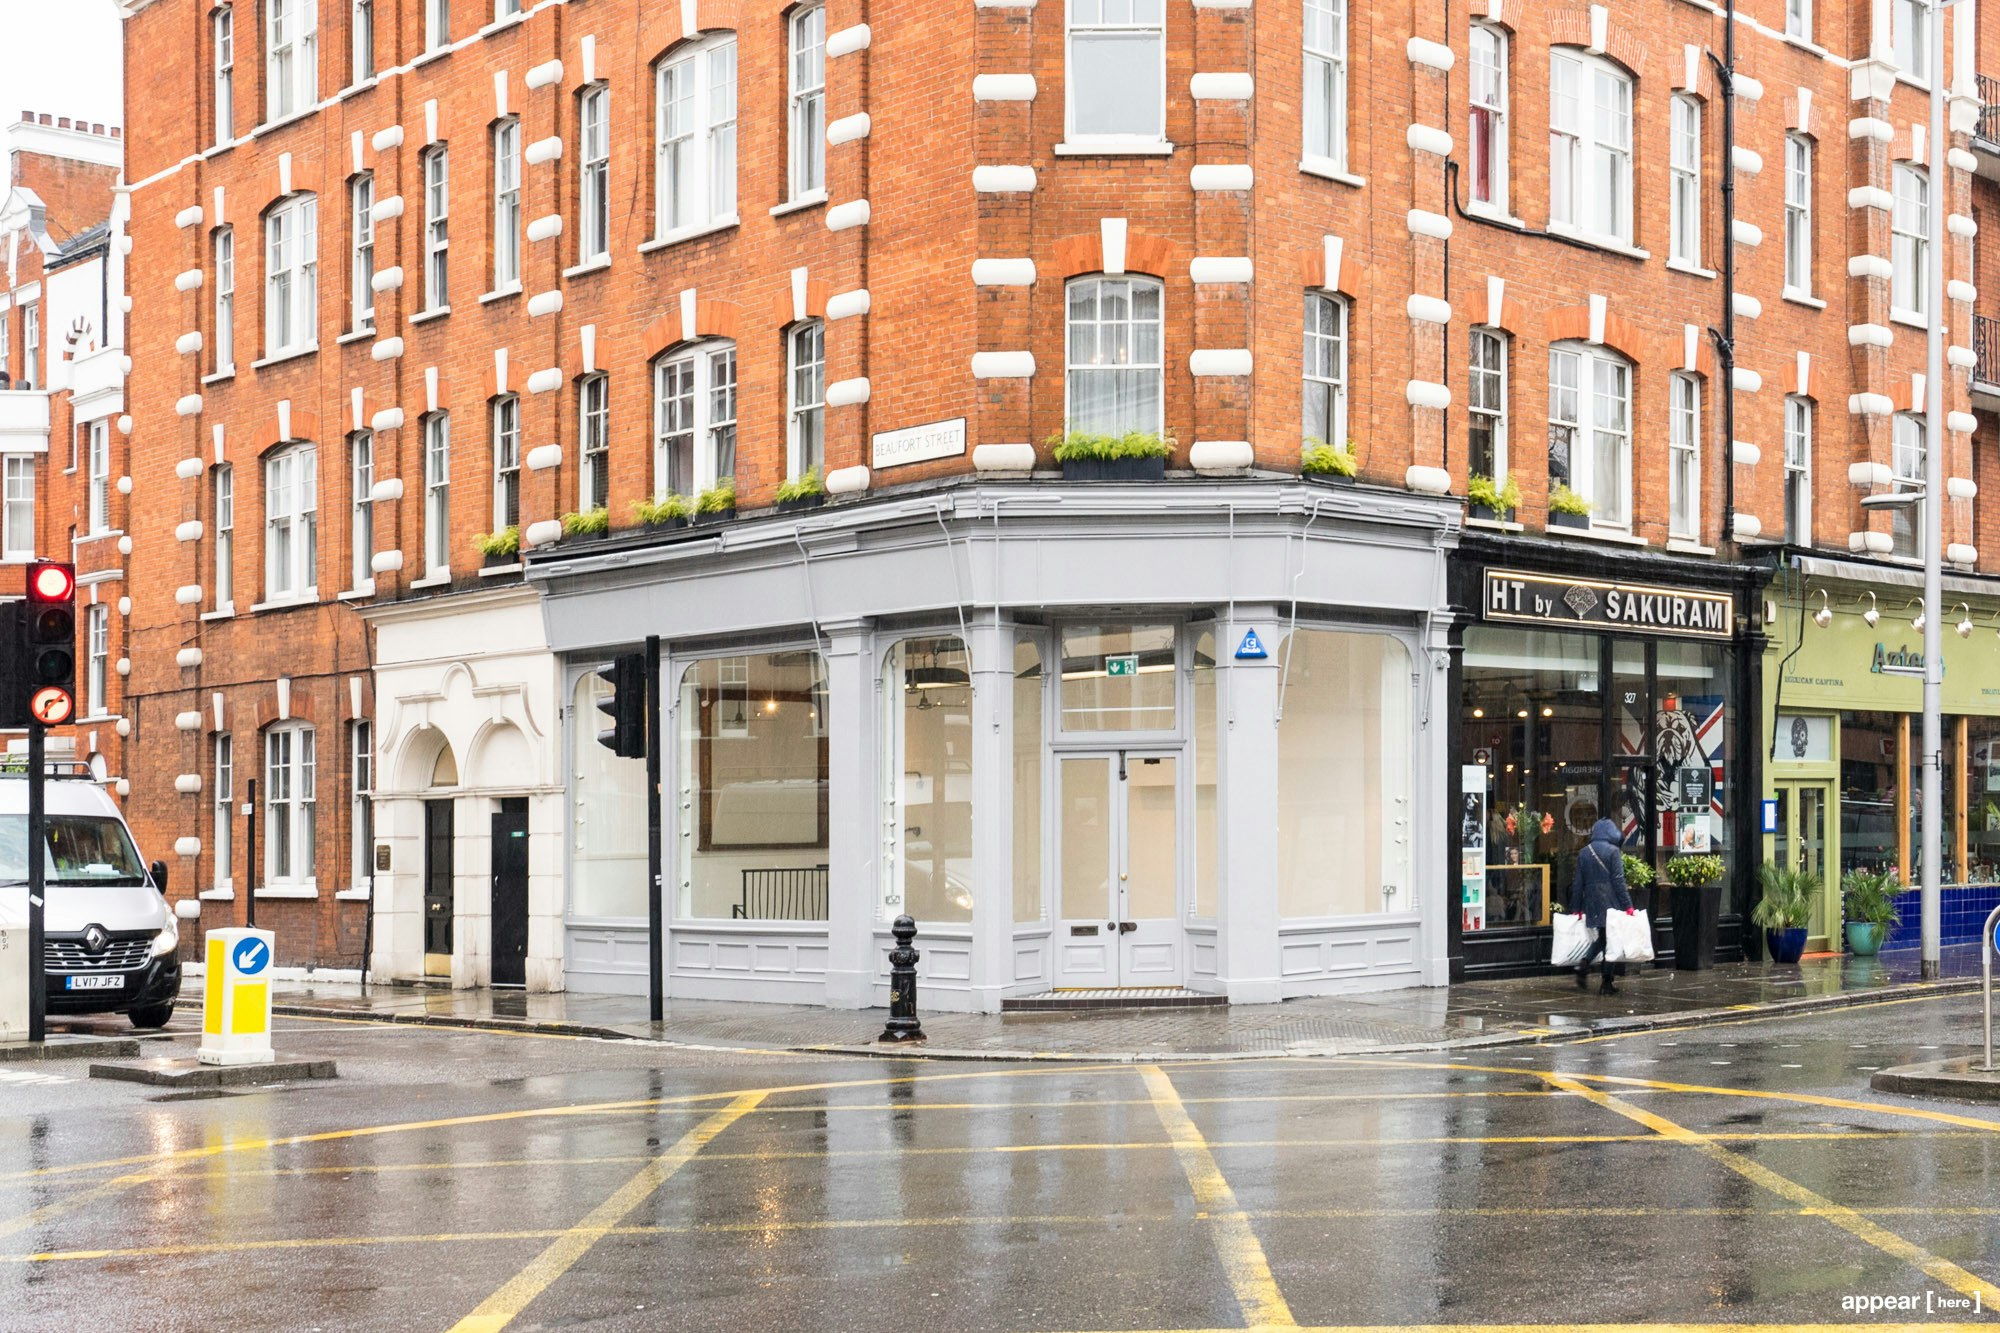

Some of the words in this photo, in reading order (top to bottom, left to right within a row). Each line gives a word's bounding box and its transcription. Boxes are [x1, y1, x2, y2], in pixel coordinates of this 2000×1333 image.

[875, 437, 921, 456] BEAUFORT
[925, 429, 960, 448] STREET
[1492, 579, 1525, 611] HT
[1535, 594, 1552, 617] by
[75, 977, 98, 987] LV17
[101, 976, 120, 987] JFZ
